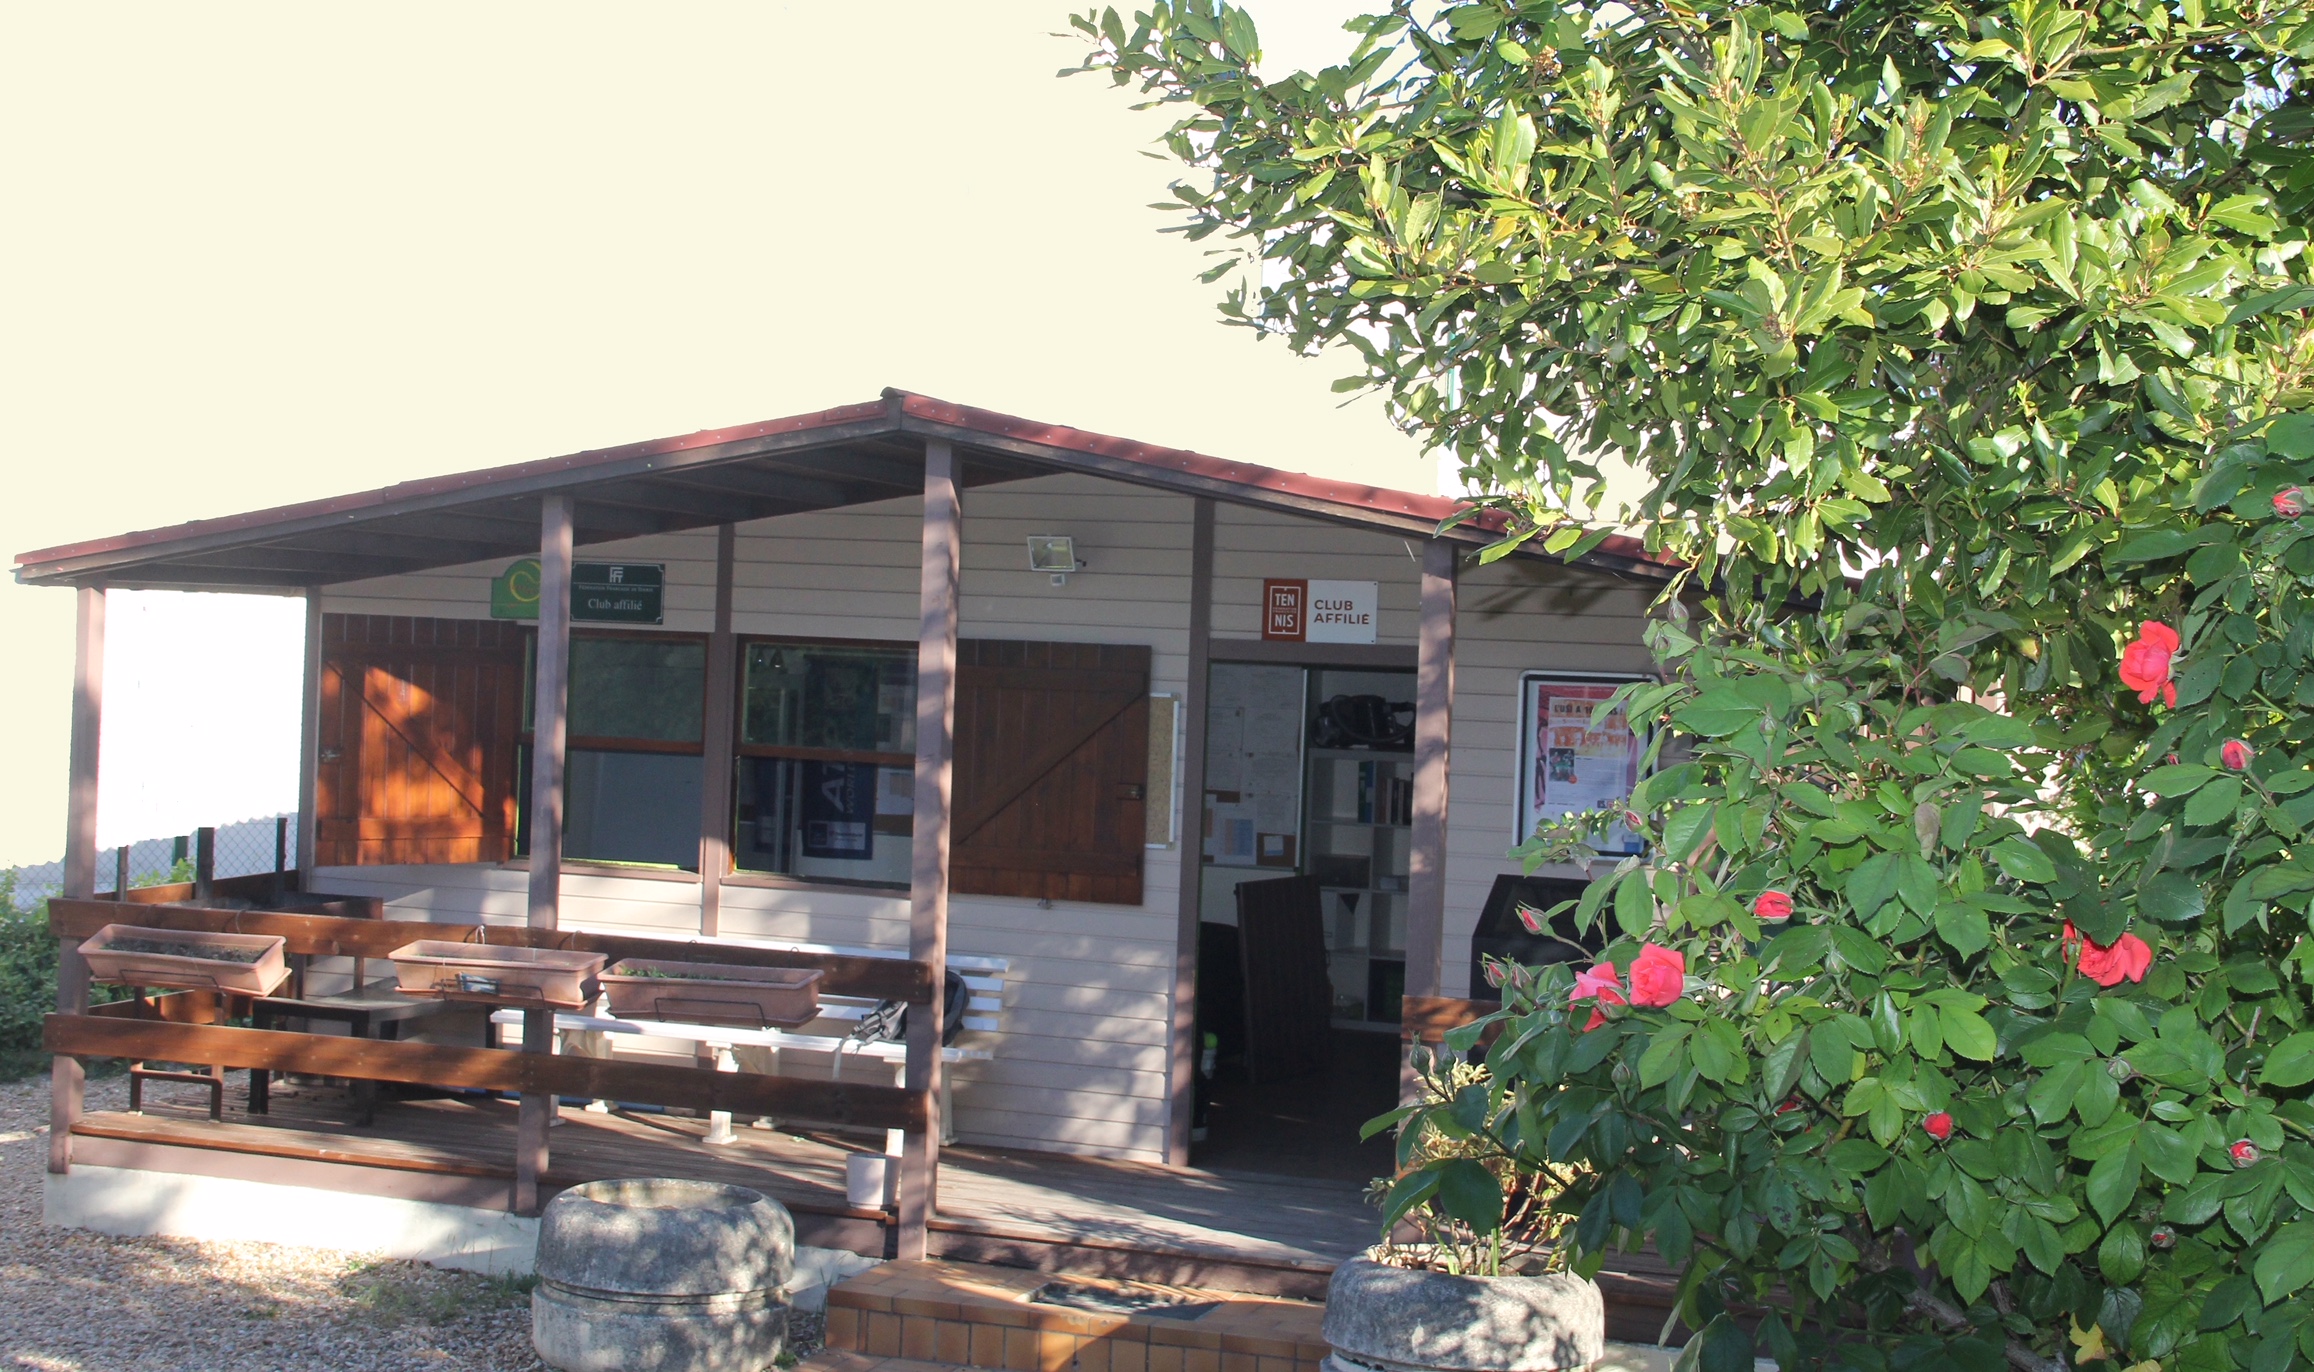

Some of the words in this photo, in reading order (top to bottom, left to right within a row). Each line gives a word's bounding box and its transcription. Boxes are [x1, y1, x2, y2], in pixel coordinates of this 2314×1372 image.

[588, 598, 611, 609] Club
[614, 598, 643, 610] affilié
[1274, 593, 1295, 606] TEN
[1314, 599, 1353, 611] CLUB
[1274, 614, 1294, 627] NIS
[1313, 612, 1370, 625] AFFILIÉ
